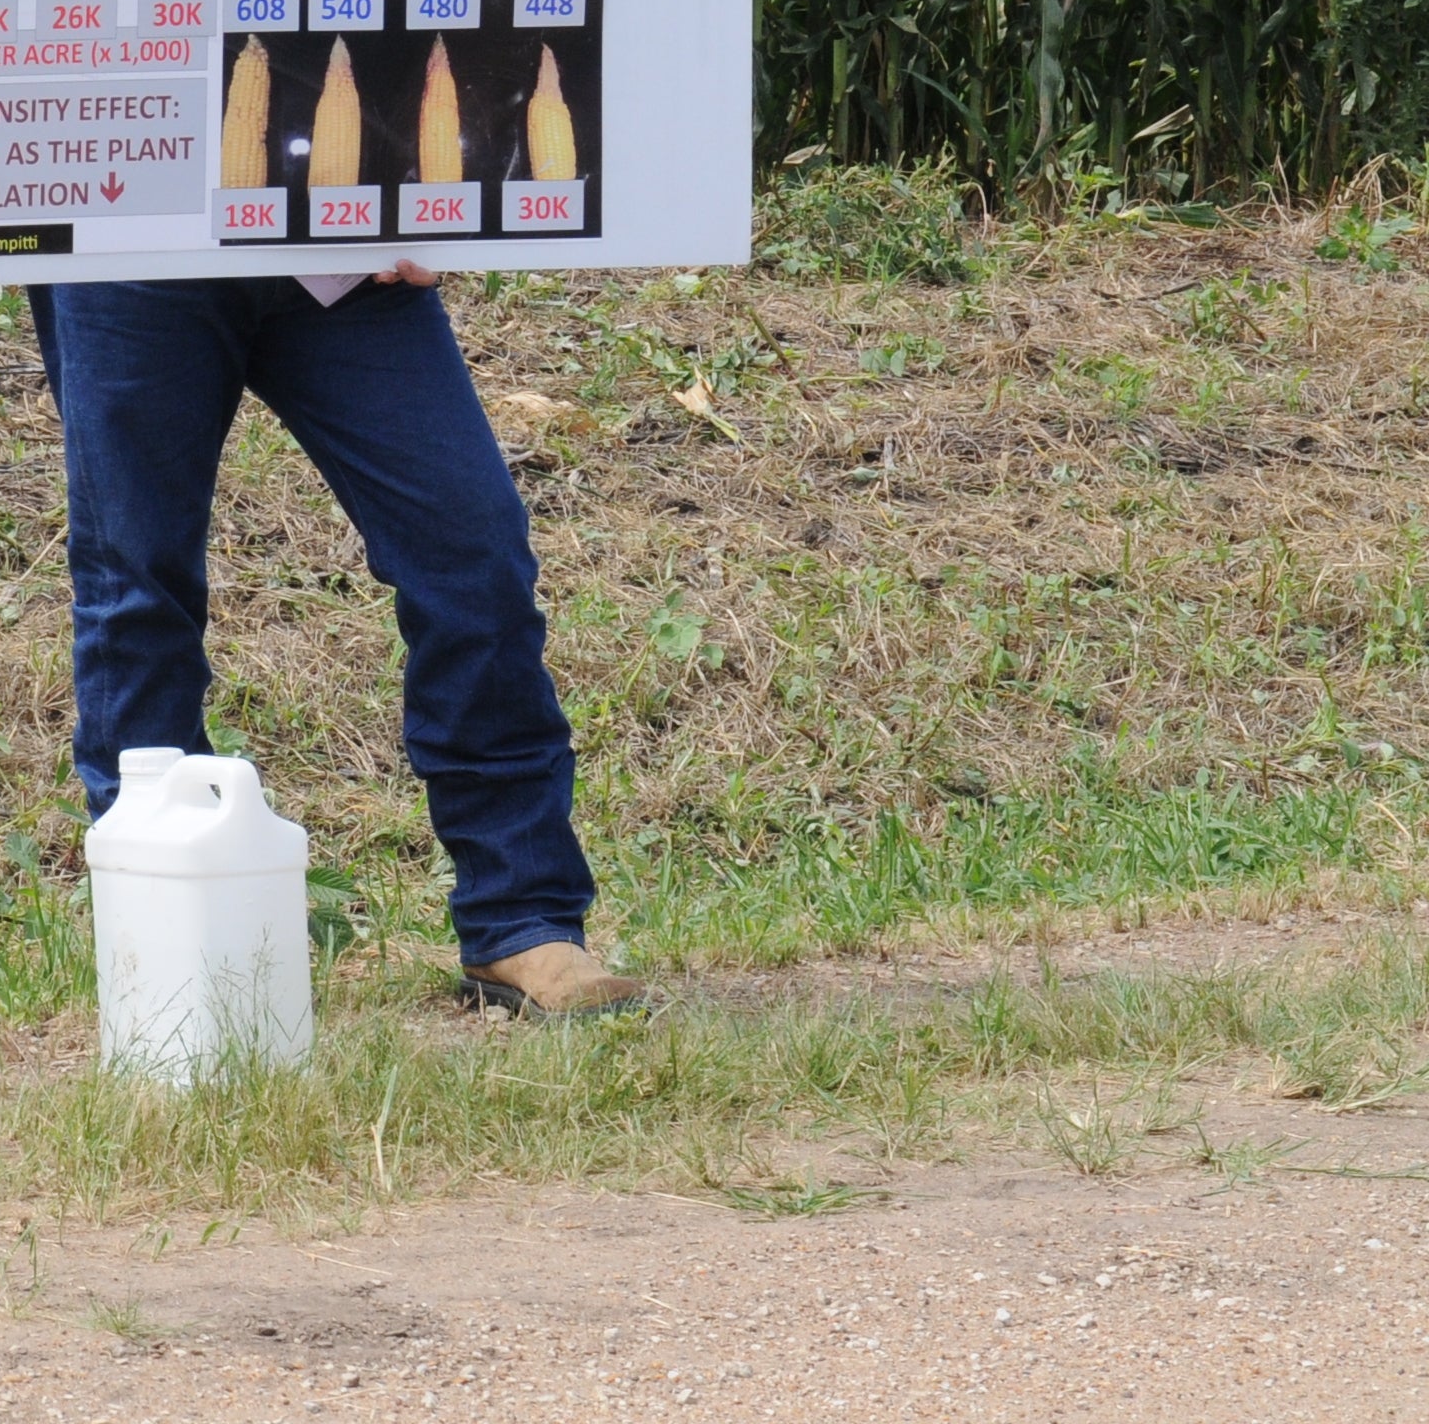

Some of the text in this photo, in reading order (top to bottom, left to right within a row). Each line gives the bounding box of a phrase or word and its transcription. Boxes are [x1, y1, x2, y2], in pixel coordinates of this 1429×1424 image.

[53, 5, 101, 29] 26K
[153, 2, 202, 26] 30K
[24, 42, 83, 65] ACRE
[91, 41, 111, 67] (x
[119, 38, 191, 65] 1,000)
[79, 95, 180, 121] EFFECT:
[6, 141, 40, 165] AS
[48, 140, 98, 163] THE
[108, 136, 194, 162] PLANT
[224, 196, 569, 228] 18K 22K 26K 30K
